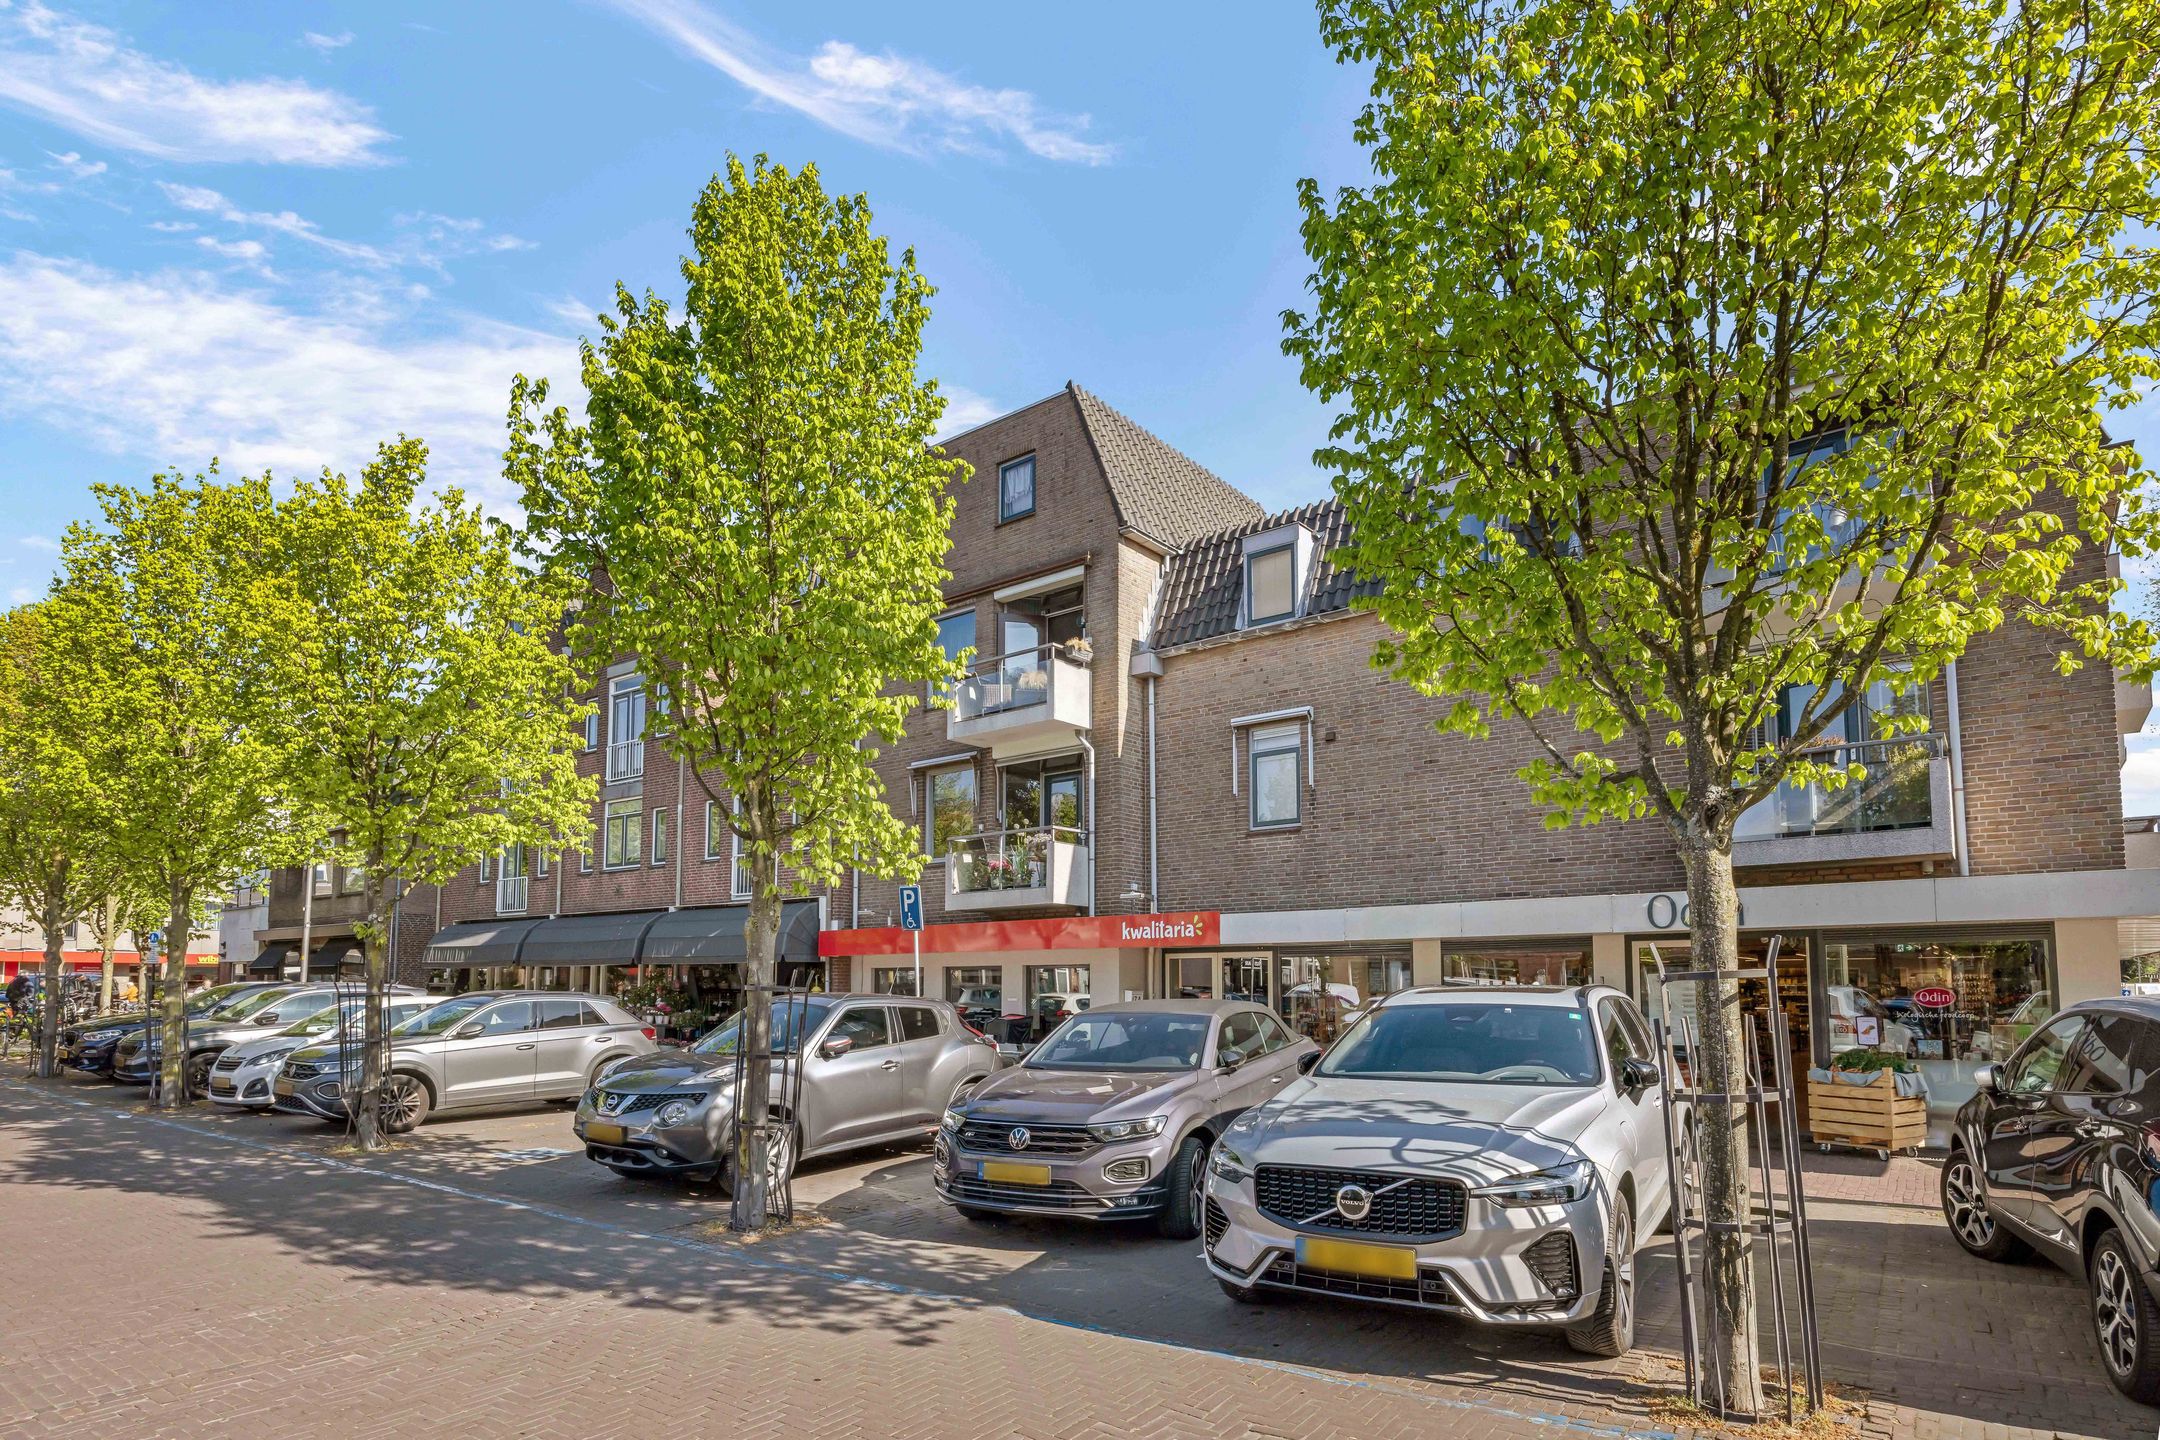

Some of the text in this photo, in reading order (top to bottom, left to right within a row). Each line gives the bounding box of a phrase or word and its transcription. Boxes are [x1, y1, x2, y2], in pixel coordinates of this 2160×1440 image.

[903, 890, 915, 912] P
[1122, 921, 1194, 939] kwalitaria
[1919, 991, 1951, 1002] Odin
